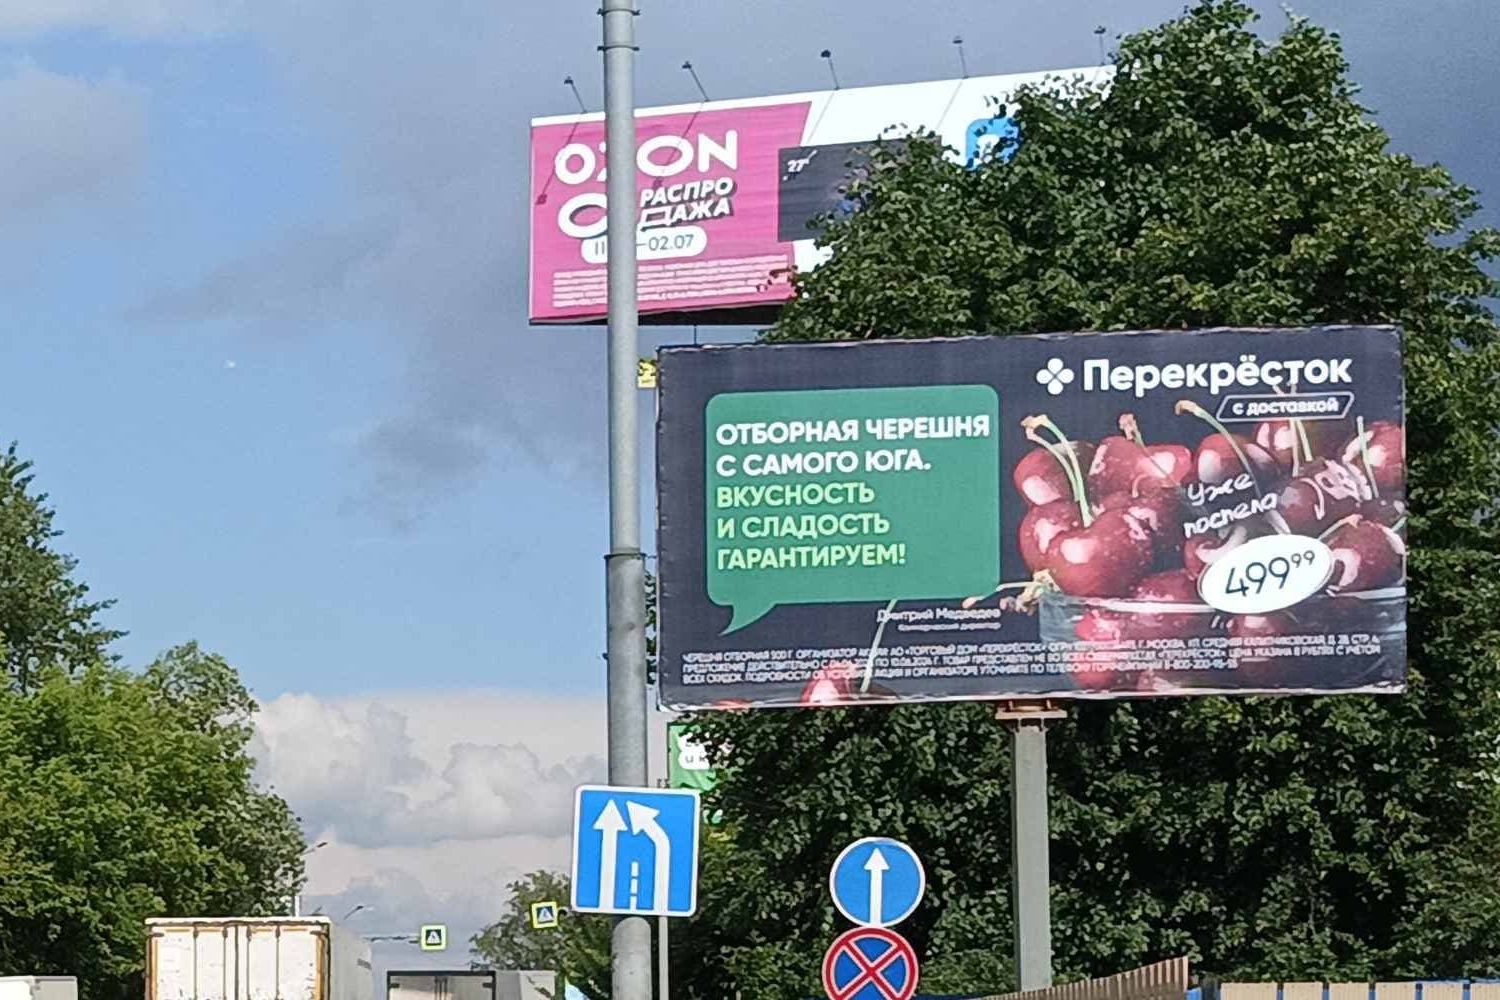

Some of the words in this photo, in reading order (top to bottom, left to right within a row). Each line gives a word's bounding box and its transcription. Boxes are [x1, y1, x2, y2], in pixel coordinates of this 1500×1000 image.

[640, 177, 735, 207] РАСПРО
[638, 198, 732, 227] ДАЖА
[1083, 354, 1353, 397] Перекрёсток
[1246, 398, 1340, 416] доставкой
[716, 419, 859, 446] ОТБОРНАЯ
[866, 415, 990, 440] ЧЕРЕШНЯ
[716, 455, 737, 477] С
[742, 450, 859, 476] САМОГО
[865, 448, 932, 472] ЮГА.
[716, 482, 876, 508] ВКУСНОСТЬ
[717, 518, 735, 538] И
[742, 512, 891, 539] СЛАДОСТЬ
[717, 543, 907, 570] ГАРАНТИРУЕМ!
